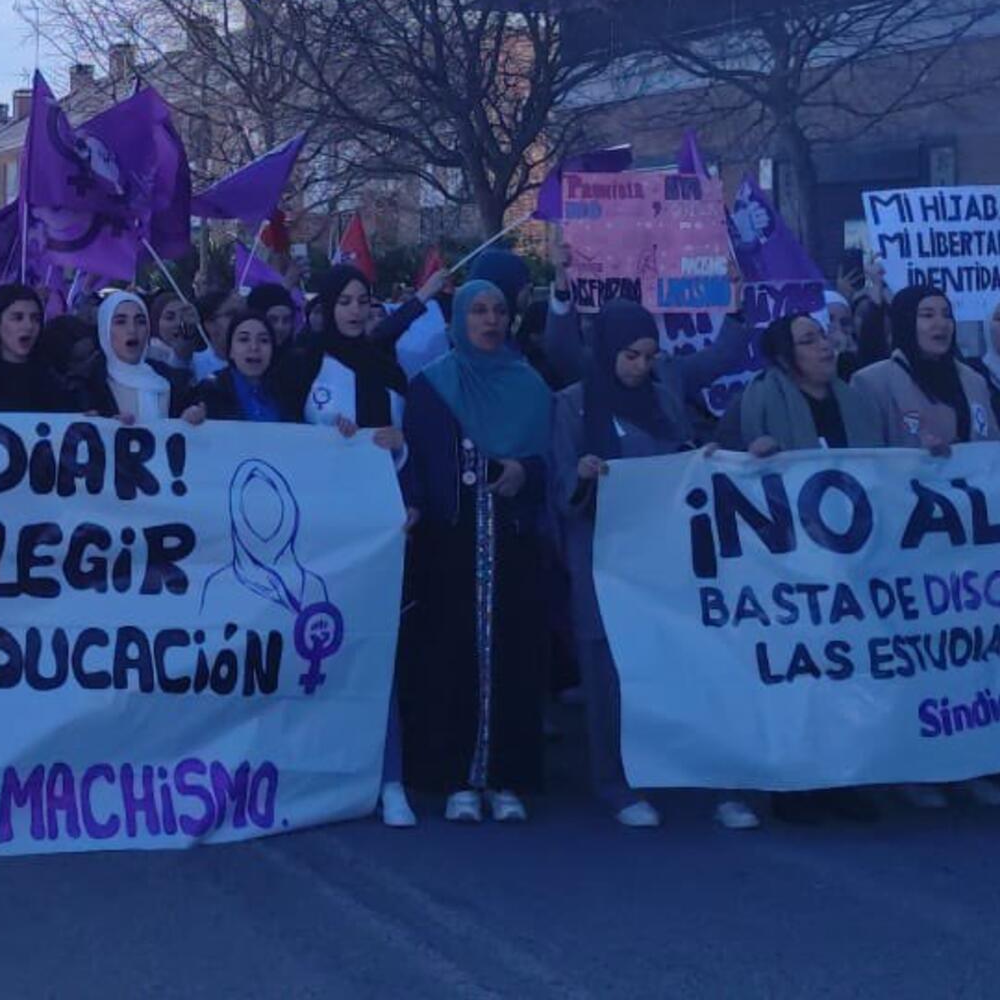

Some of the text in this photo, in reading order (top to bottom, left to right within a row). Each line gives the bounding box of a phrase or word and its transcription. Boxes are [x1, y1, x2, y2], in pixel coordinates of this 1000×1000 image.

[685, 469, 1000, 578] ¡NO AL
[700, 582, 866, 628] BASTA
[869, 577, 920, 620] DE
[755, 640, 856, 685] LAS
